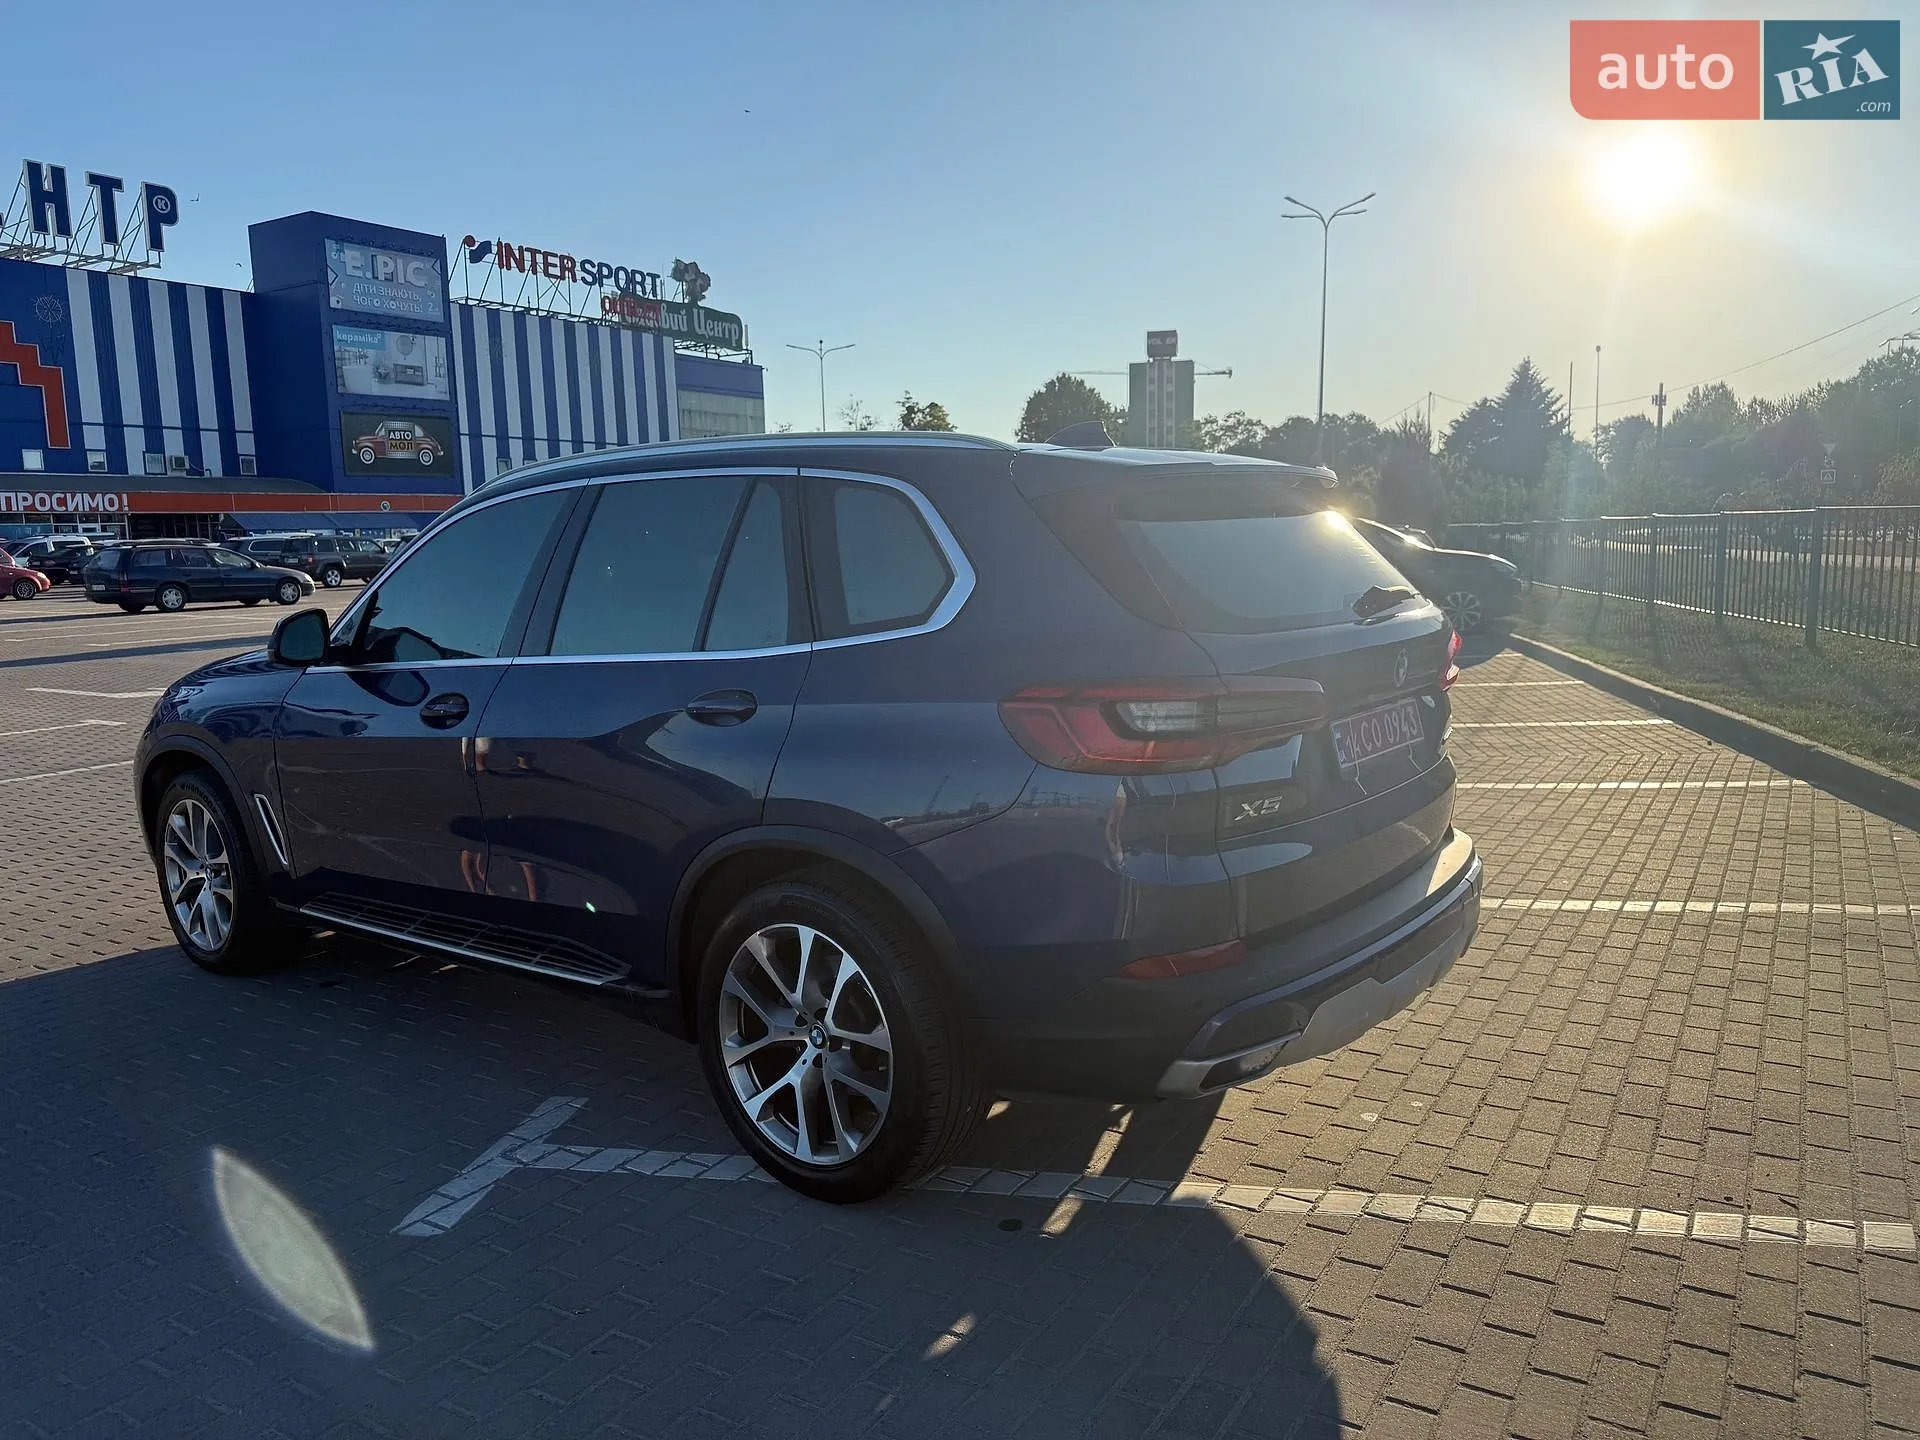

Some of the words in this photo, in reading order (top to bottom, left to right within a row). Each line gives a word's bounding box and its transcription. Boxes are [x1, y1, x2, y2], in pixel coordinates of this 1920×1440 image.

[0, 158, 180, 252] НТР
[353, 283, 376, 295] ДІТИ
[353, 295, 381, 308] ЧОГО
[383, 298, 423, 313] ХОЧУТЬ!
[693, 307, 740, 346] Центр
[389, 431, 412, 440] АВТО
[389, 441, 413, 451] МОЛ
[0, 491, 129, 512] ПРОСИМО!
[1234, 795, 1283, 822] X5
